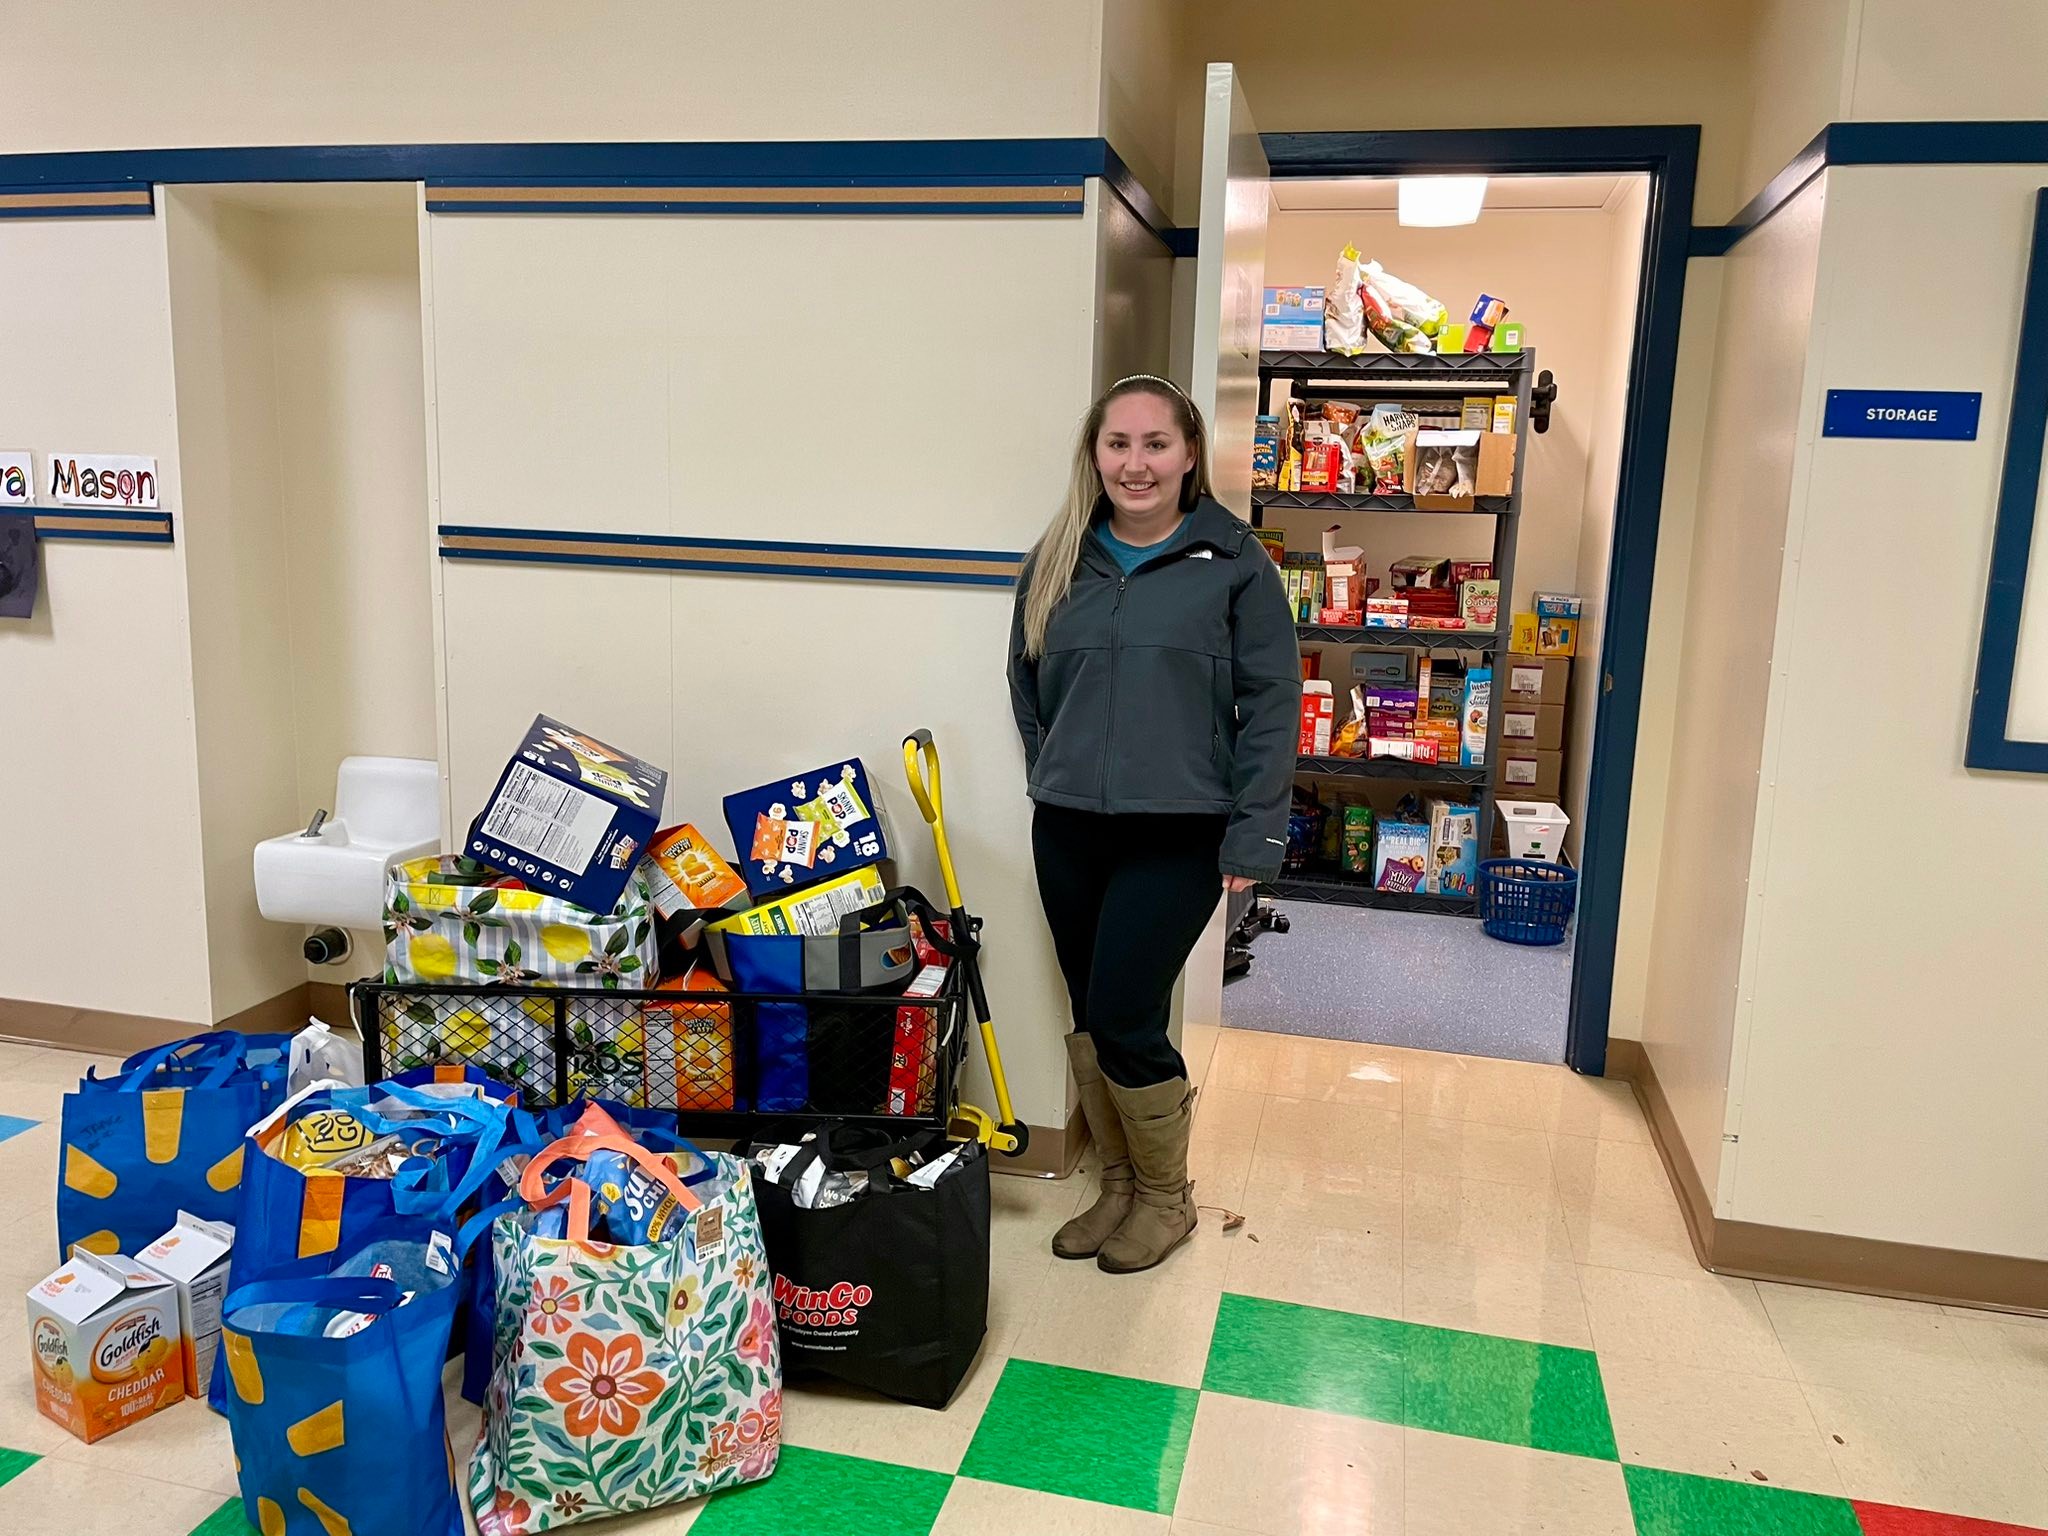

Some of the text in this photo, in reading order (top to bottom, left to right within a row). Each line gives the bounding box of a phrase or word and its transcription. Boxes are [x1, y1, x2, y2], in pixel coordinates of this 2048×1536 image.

[1383, 411, 1417, 427] HARVEST
[1391, 420, 1416, 432] SNAPS
[1866, 408, 1938, 422] STORAGE
[51, 458, 156, 505] Mason
[827, 796, 846, 820] POP
[837, 791, 857, 815] SKINNY
[786, 828, 799, 854] POP
[800, 830, 810, 856] SKINNY
[858, 831, 880, 857] 18
[1390, 870, 1414, 886] MINI
[573, 1051, 643, 1076] ROS
[335, 1113, 359, 1142] GO
[643, 1180, 667, 1209] CHI
[823, 1188, 838, 1199] We
[649, 1219, 662, 1240] 100%
[773, 1273, 872, 1311] WinCo
[780, 1305, 858, 1327] FOODS
[100, 1316, 162, 1368] Goldfish
[832, 1329, 860, 1337] Company
[37, 1335, 69, 1357] Goldfish
[42, 1378, 73, 1406] CHEDDAR
[108, 1367, 166, 1402] CHEDDAR
[711, 1395, 781, 1459] ROS
